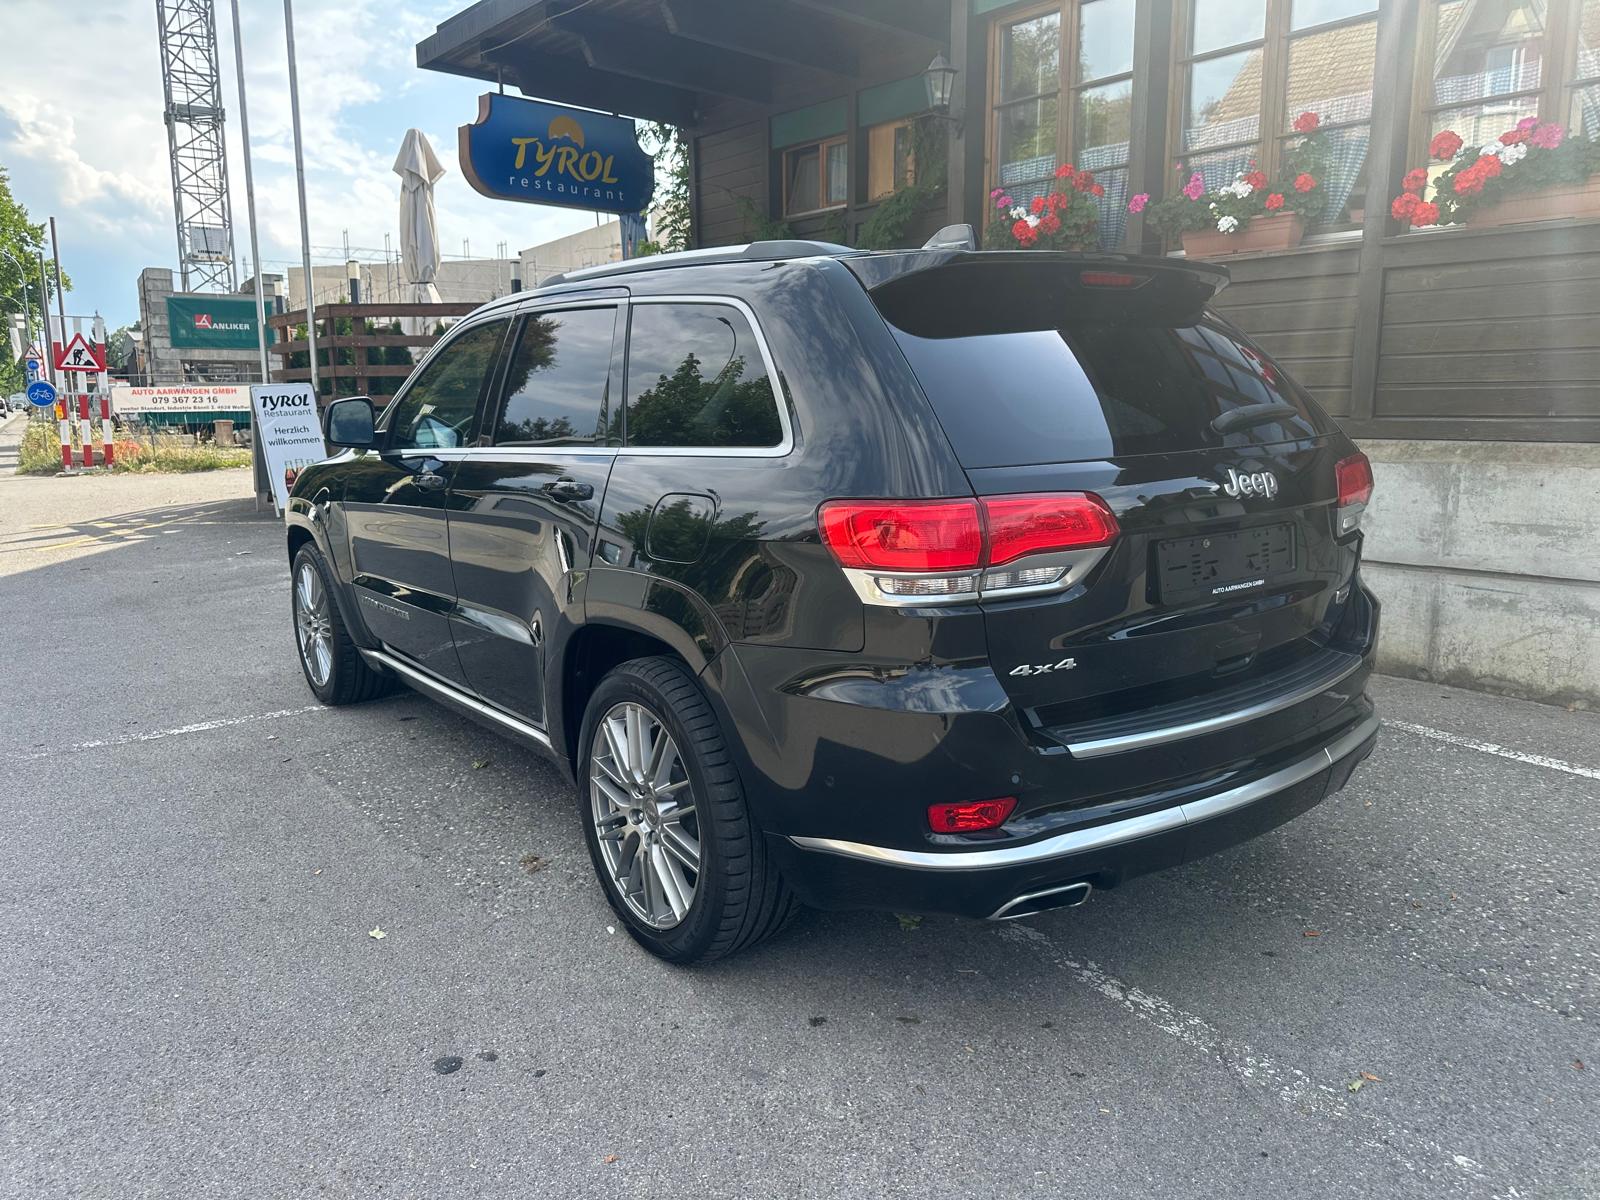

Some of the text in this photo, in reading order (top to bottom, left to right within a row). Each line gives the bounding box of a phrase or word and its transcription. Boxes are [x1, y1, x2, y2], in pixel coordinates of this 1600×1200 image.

[511, 137, 618, 184] TYROL
[509, 175, 625, 201] restaurant
[212, 322, 250, 331] ANLIKER
[152, 395, 218, 404] 079 367 23 16
[260, 394, 310, 411] TYROL
[264, 408, 312, 418] Restaurant
[275, 426, 310, 435] Herzlich
[268, 437, 320, 447] willkommen
[1223, 467, 1279, 500] Jeep
[1212, 586, 1225, 594] AUTO
[1008, 657, 1077, 677] 4x4
